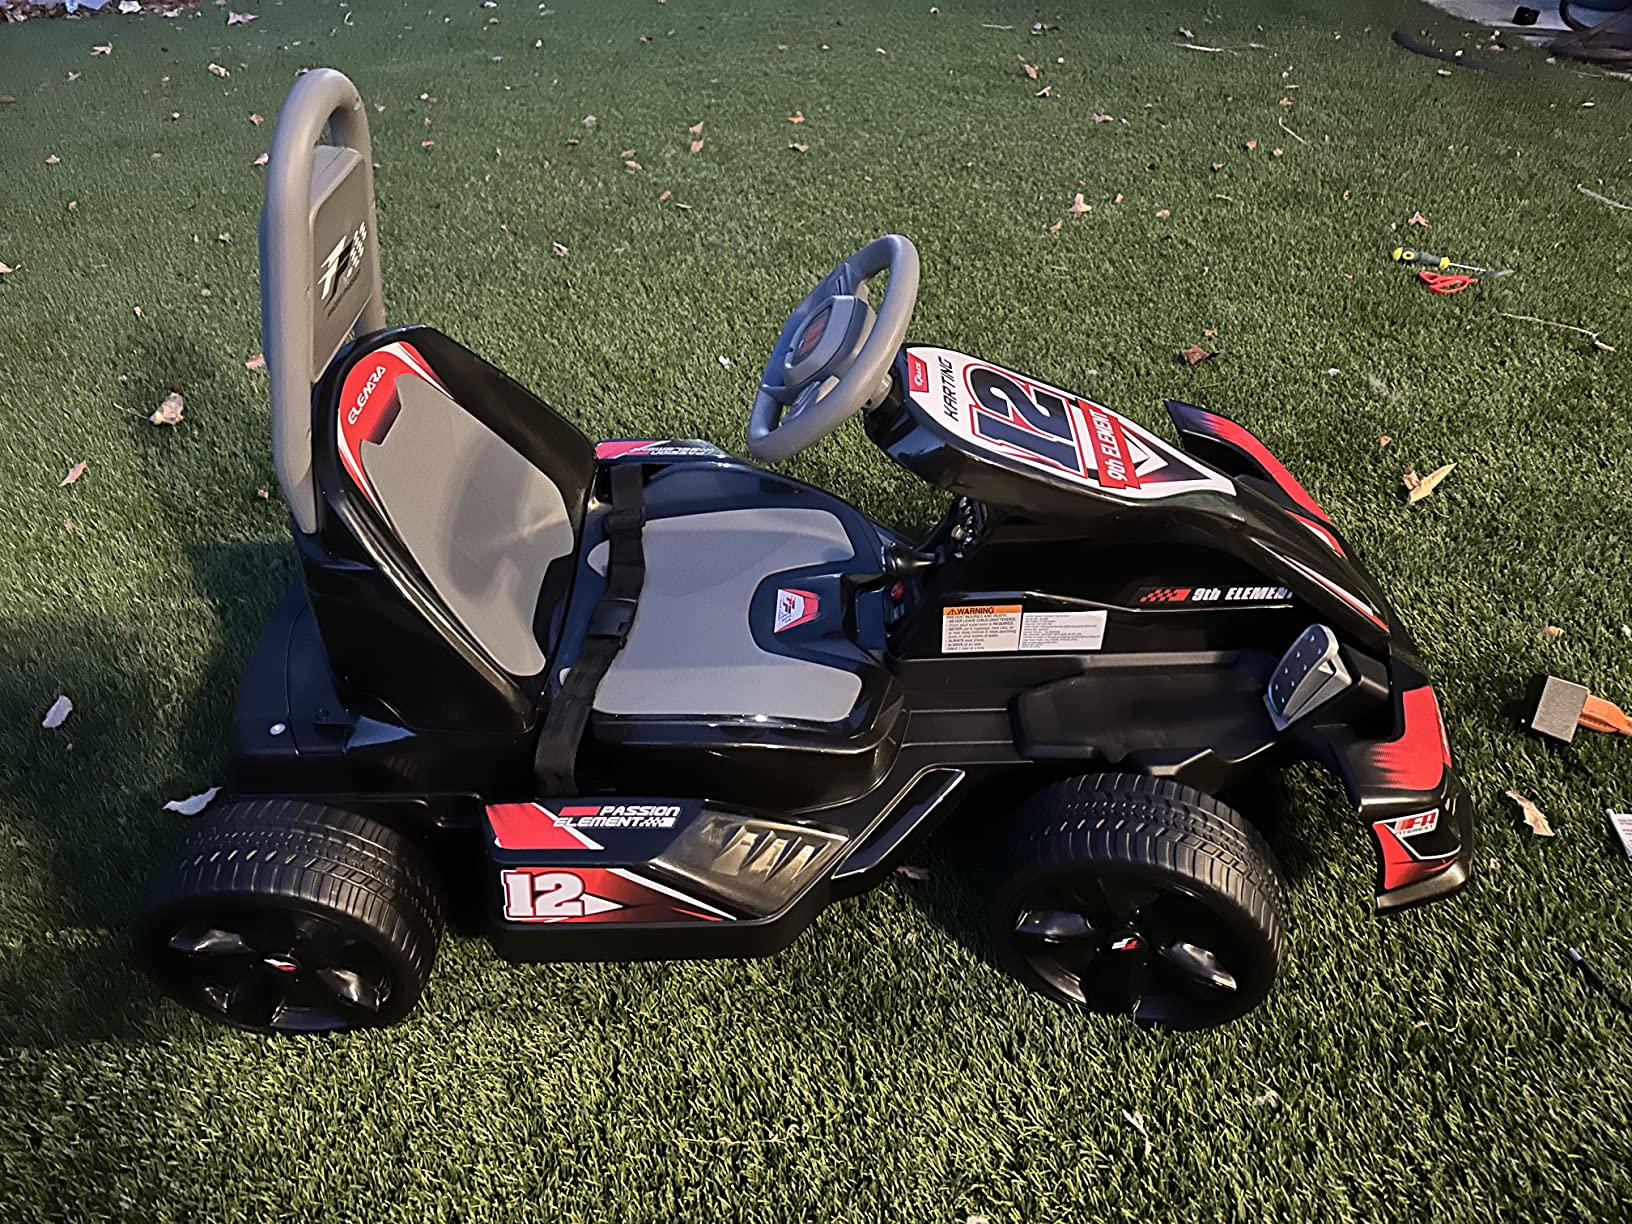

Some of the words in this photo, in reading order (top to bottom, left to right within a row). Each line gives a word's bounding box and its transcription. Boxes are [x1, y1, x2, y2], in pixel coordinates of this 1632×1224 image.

[347, 365, 387, 425] ELEMRA
[937, 355, 959, 422] KARTING
[968, 366, 1083, 475] 12
[1088, 408, 1122, 459] ELEMENT
[1104, 458, 1128, 482] 9th
[957, 606, 995, 615] WARNING
[1191, 588, 1221, 601] 9th
[552, 816, 641, 828] ELEMENT
[599, 805, 681, 816] PASSION
[505, 870, 584, 917] 12
